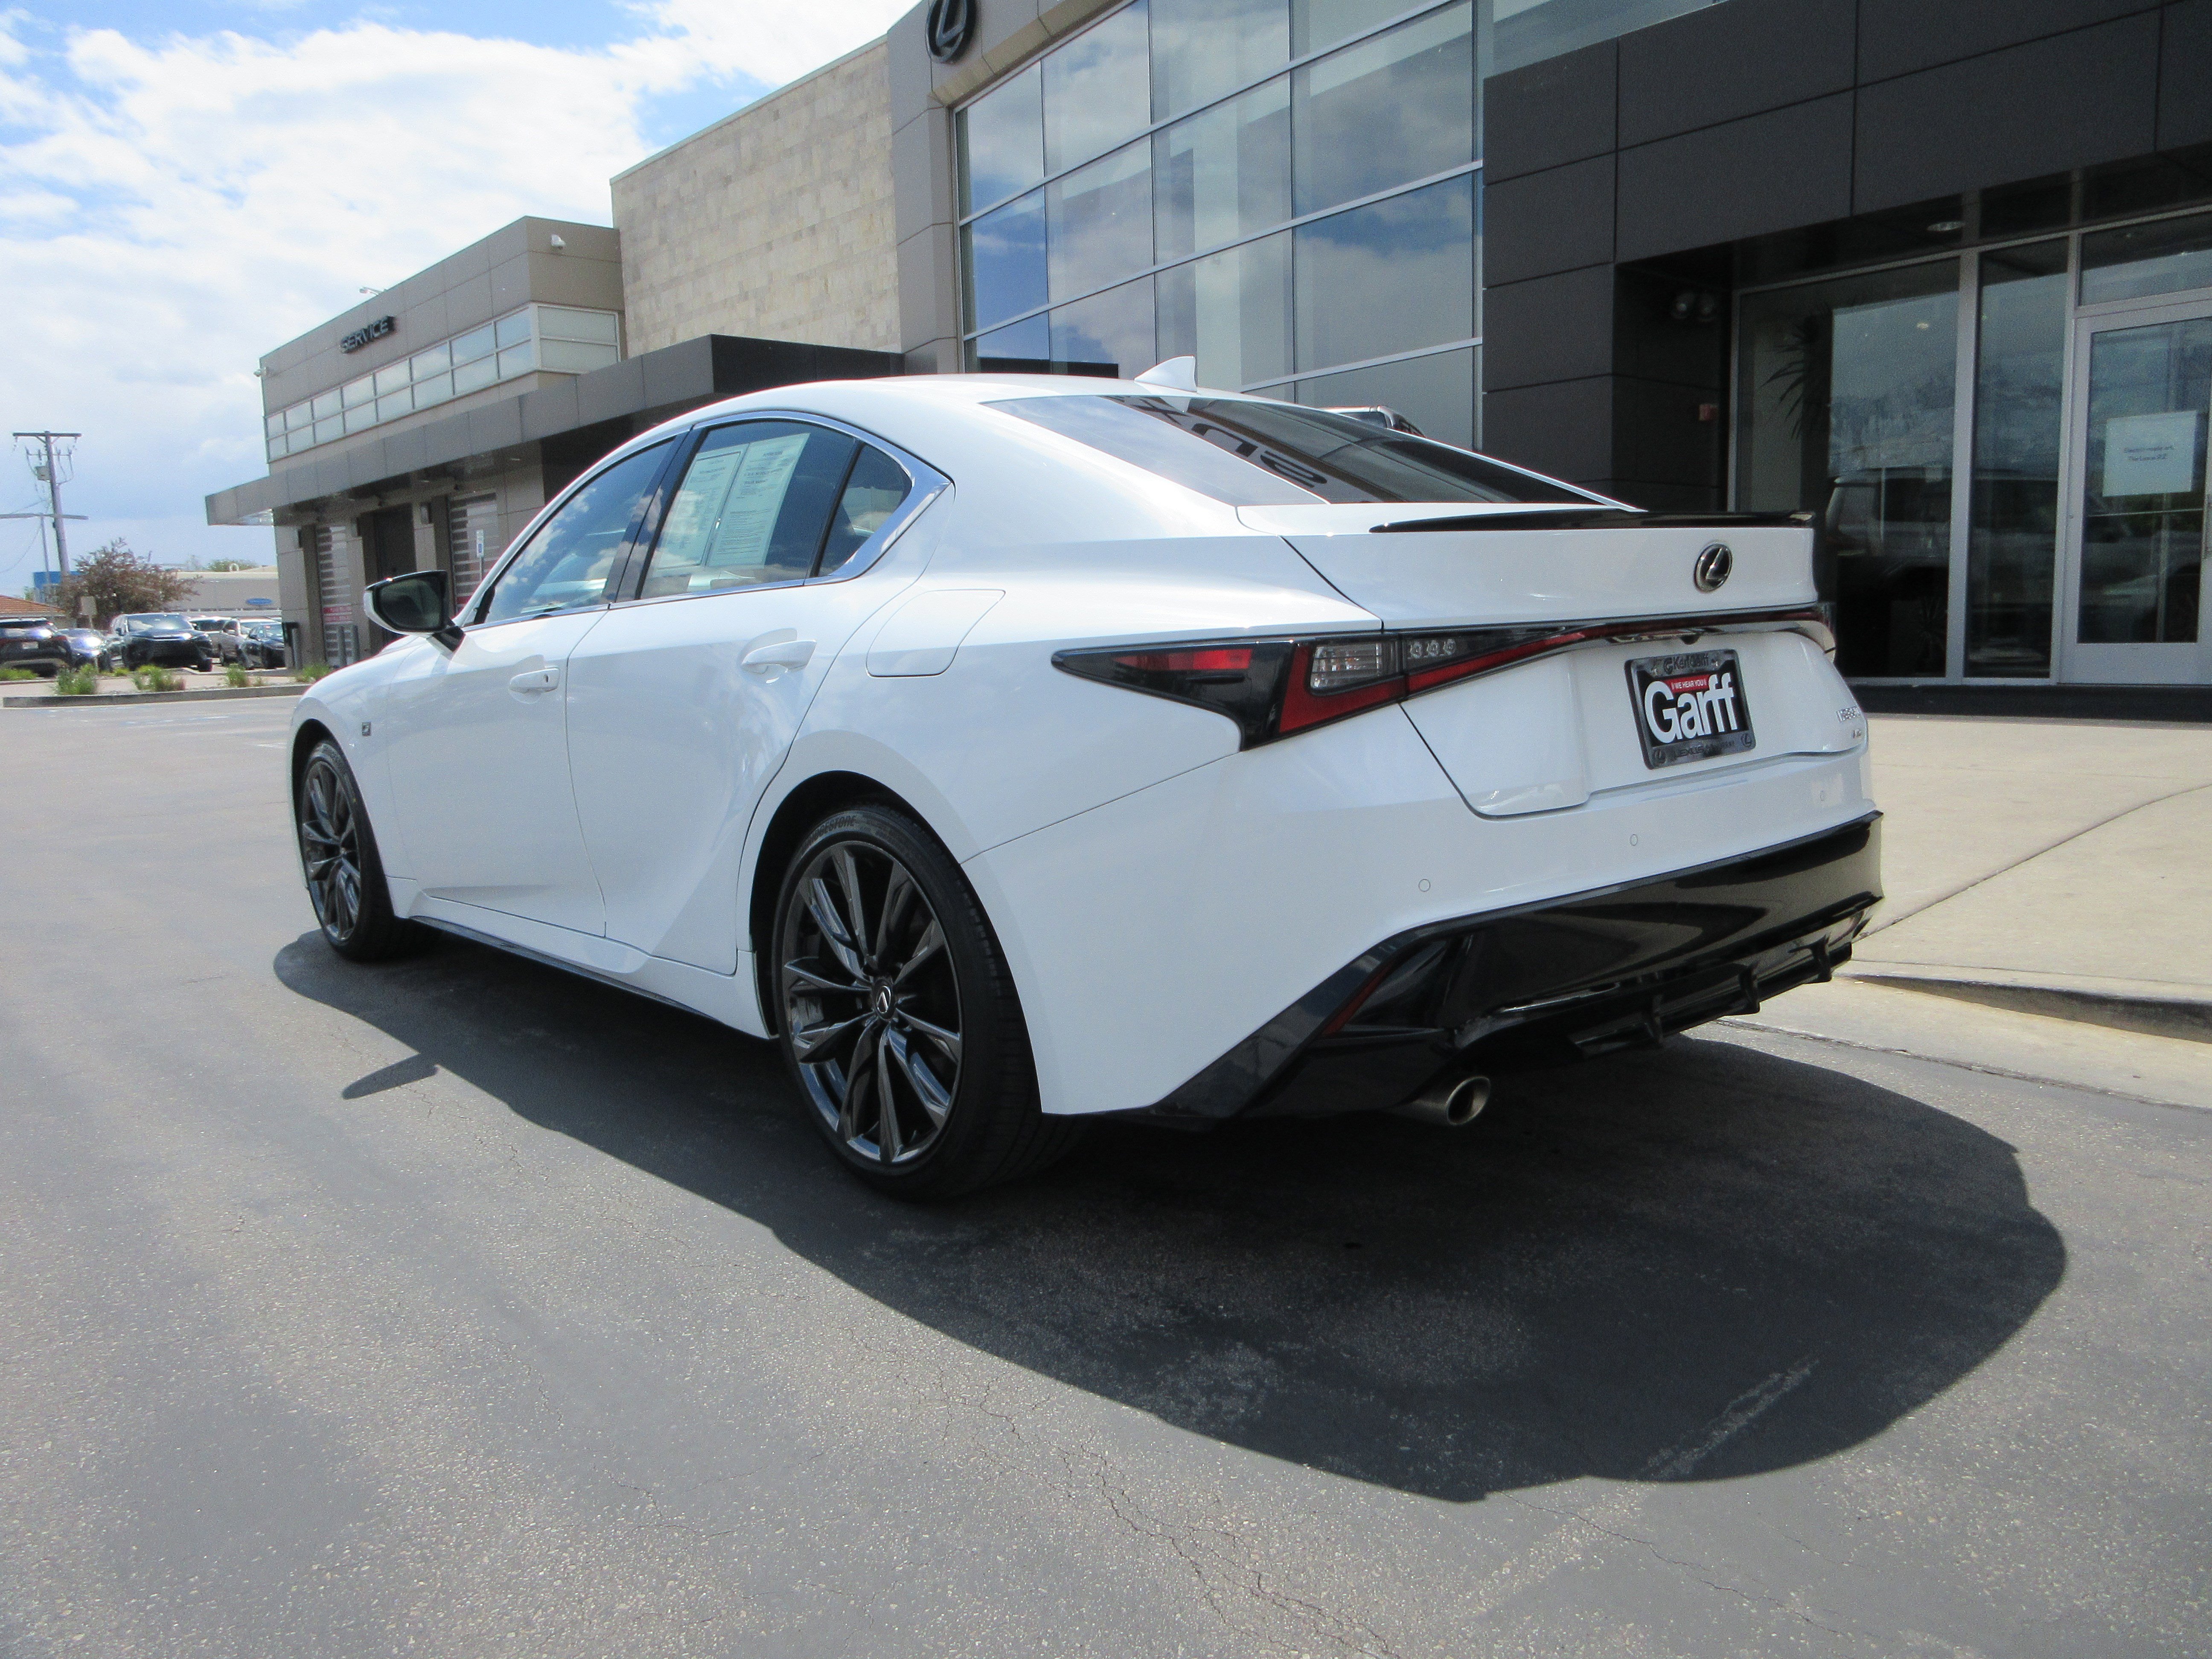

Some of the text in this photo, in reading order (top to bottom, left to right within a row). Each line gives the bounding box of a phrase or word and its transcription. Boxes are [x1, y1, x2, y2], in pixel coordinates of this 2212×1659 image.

[341, 316, 395, 354] SERVICE
[1694, 679, 1704, 687] YOU
[1644, 672, 1738, 743] Garff
